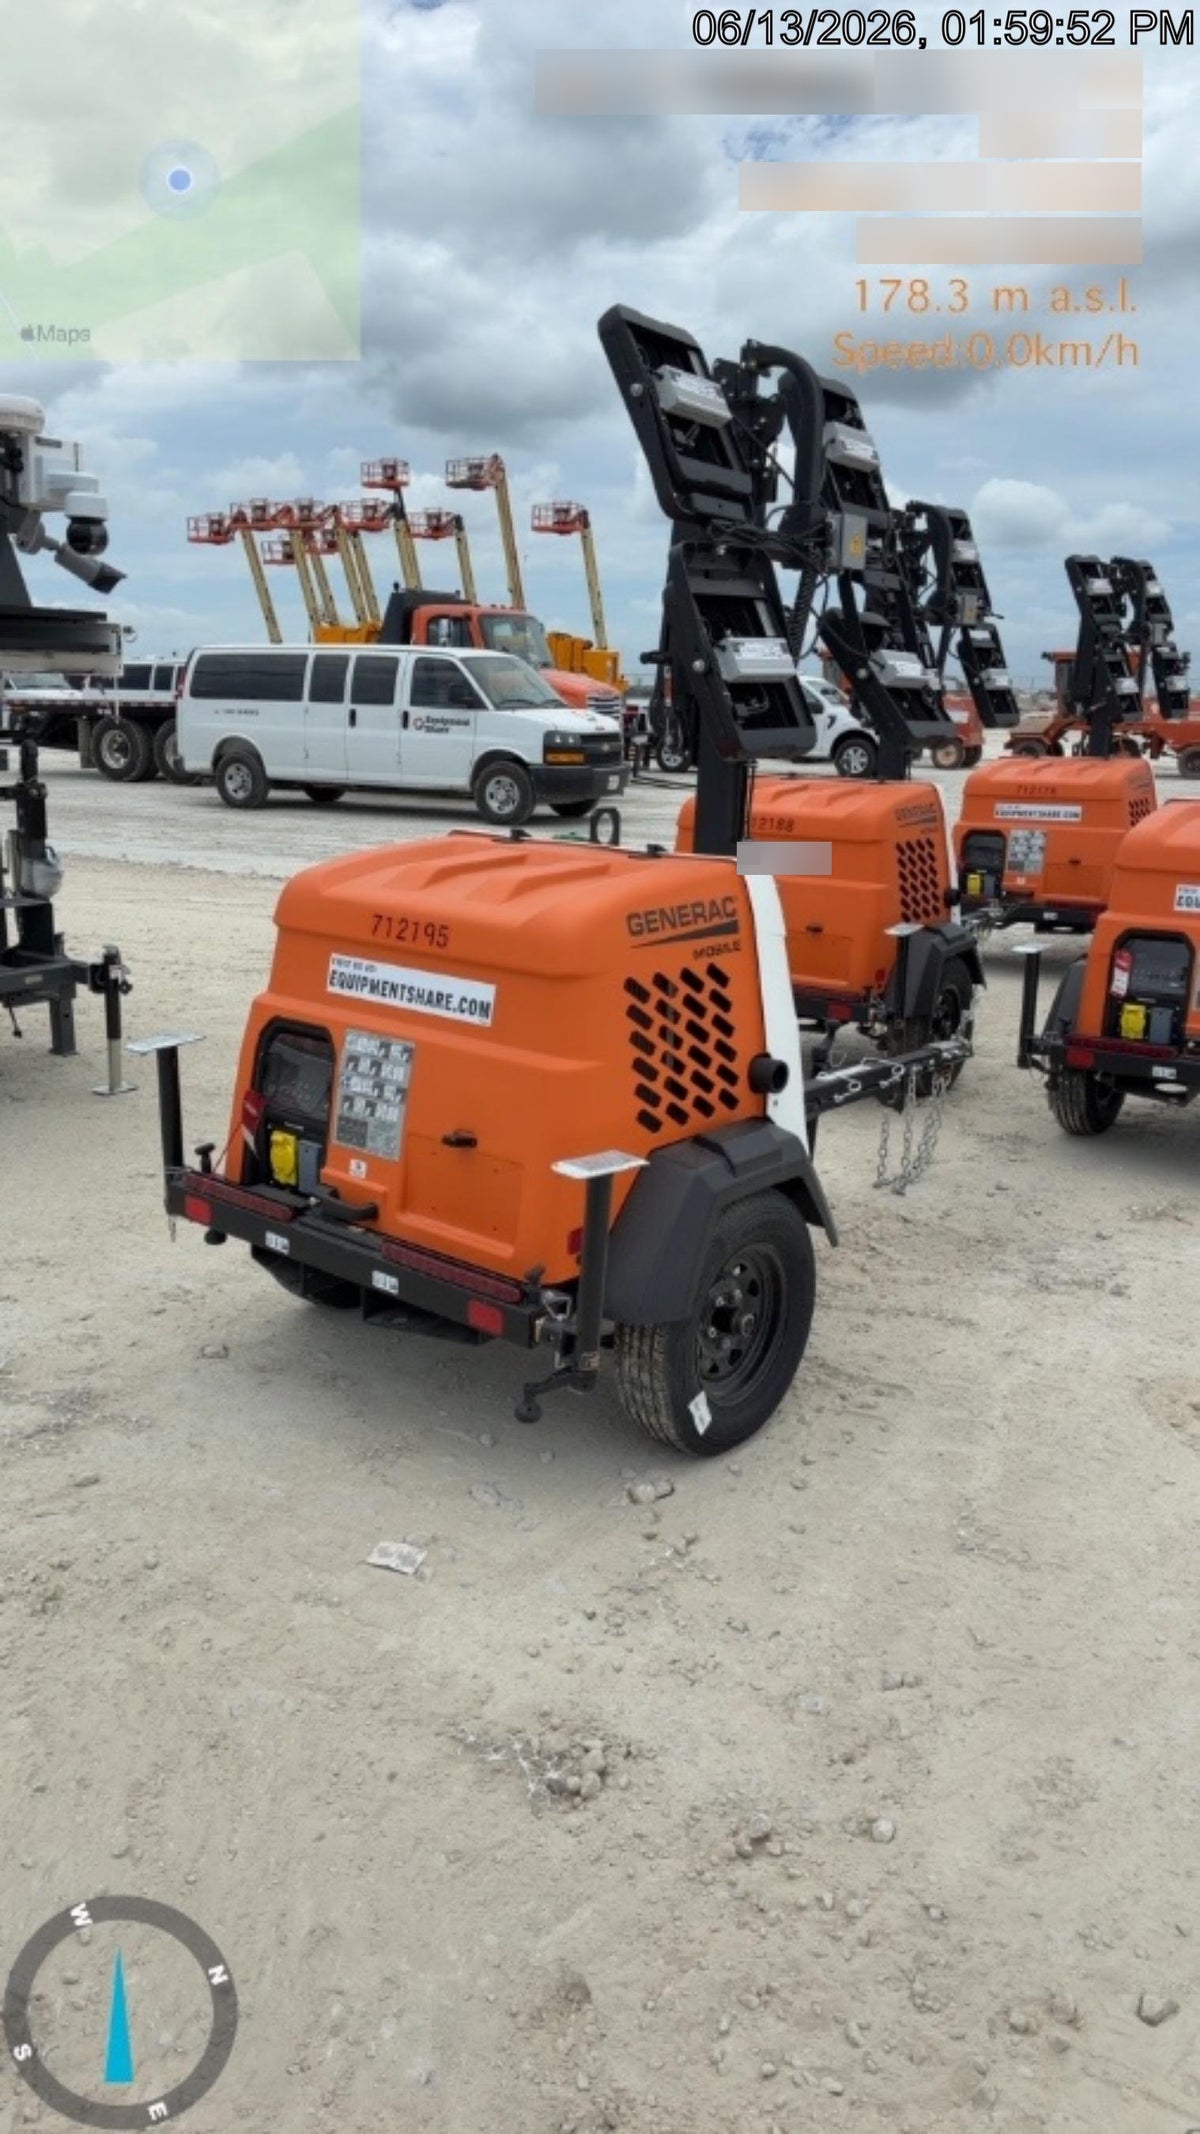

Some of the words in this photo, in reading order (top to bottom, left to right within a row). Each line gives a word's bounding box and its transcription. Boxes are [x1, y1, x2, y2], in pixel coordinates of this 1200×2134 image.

[371, 914, 450, 948] 712195
[626, 896, 738, 937] GENERAC
[329, 969, 492, 1019] EQUIPMENTSHARE.COM
